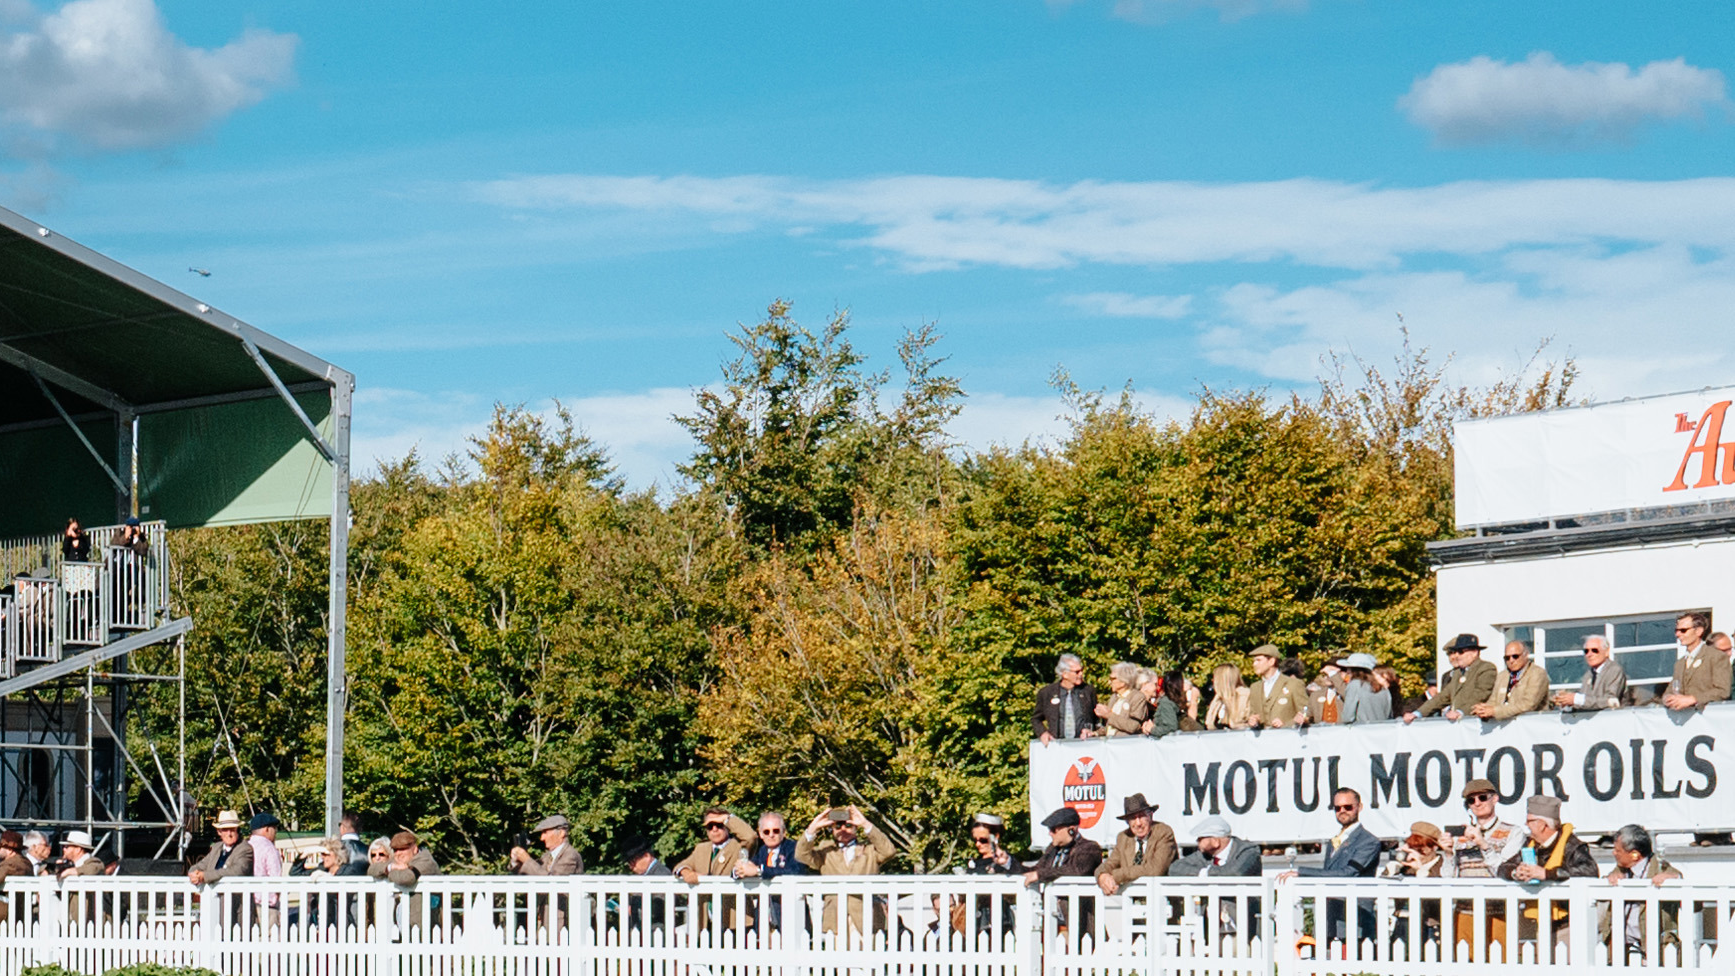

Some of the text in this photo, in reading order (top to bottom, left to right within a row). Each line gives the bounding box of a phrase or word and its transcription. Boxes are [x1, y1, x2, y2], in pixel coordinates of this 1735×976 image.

[1674, 412, 1698, 433] The
[1182, 735, 1718, 816] MOTUL MOTOR OILS
[1064, 785, 1105, 801] MOTUL
